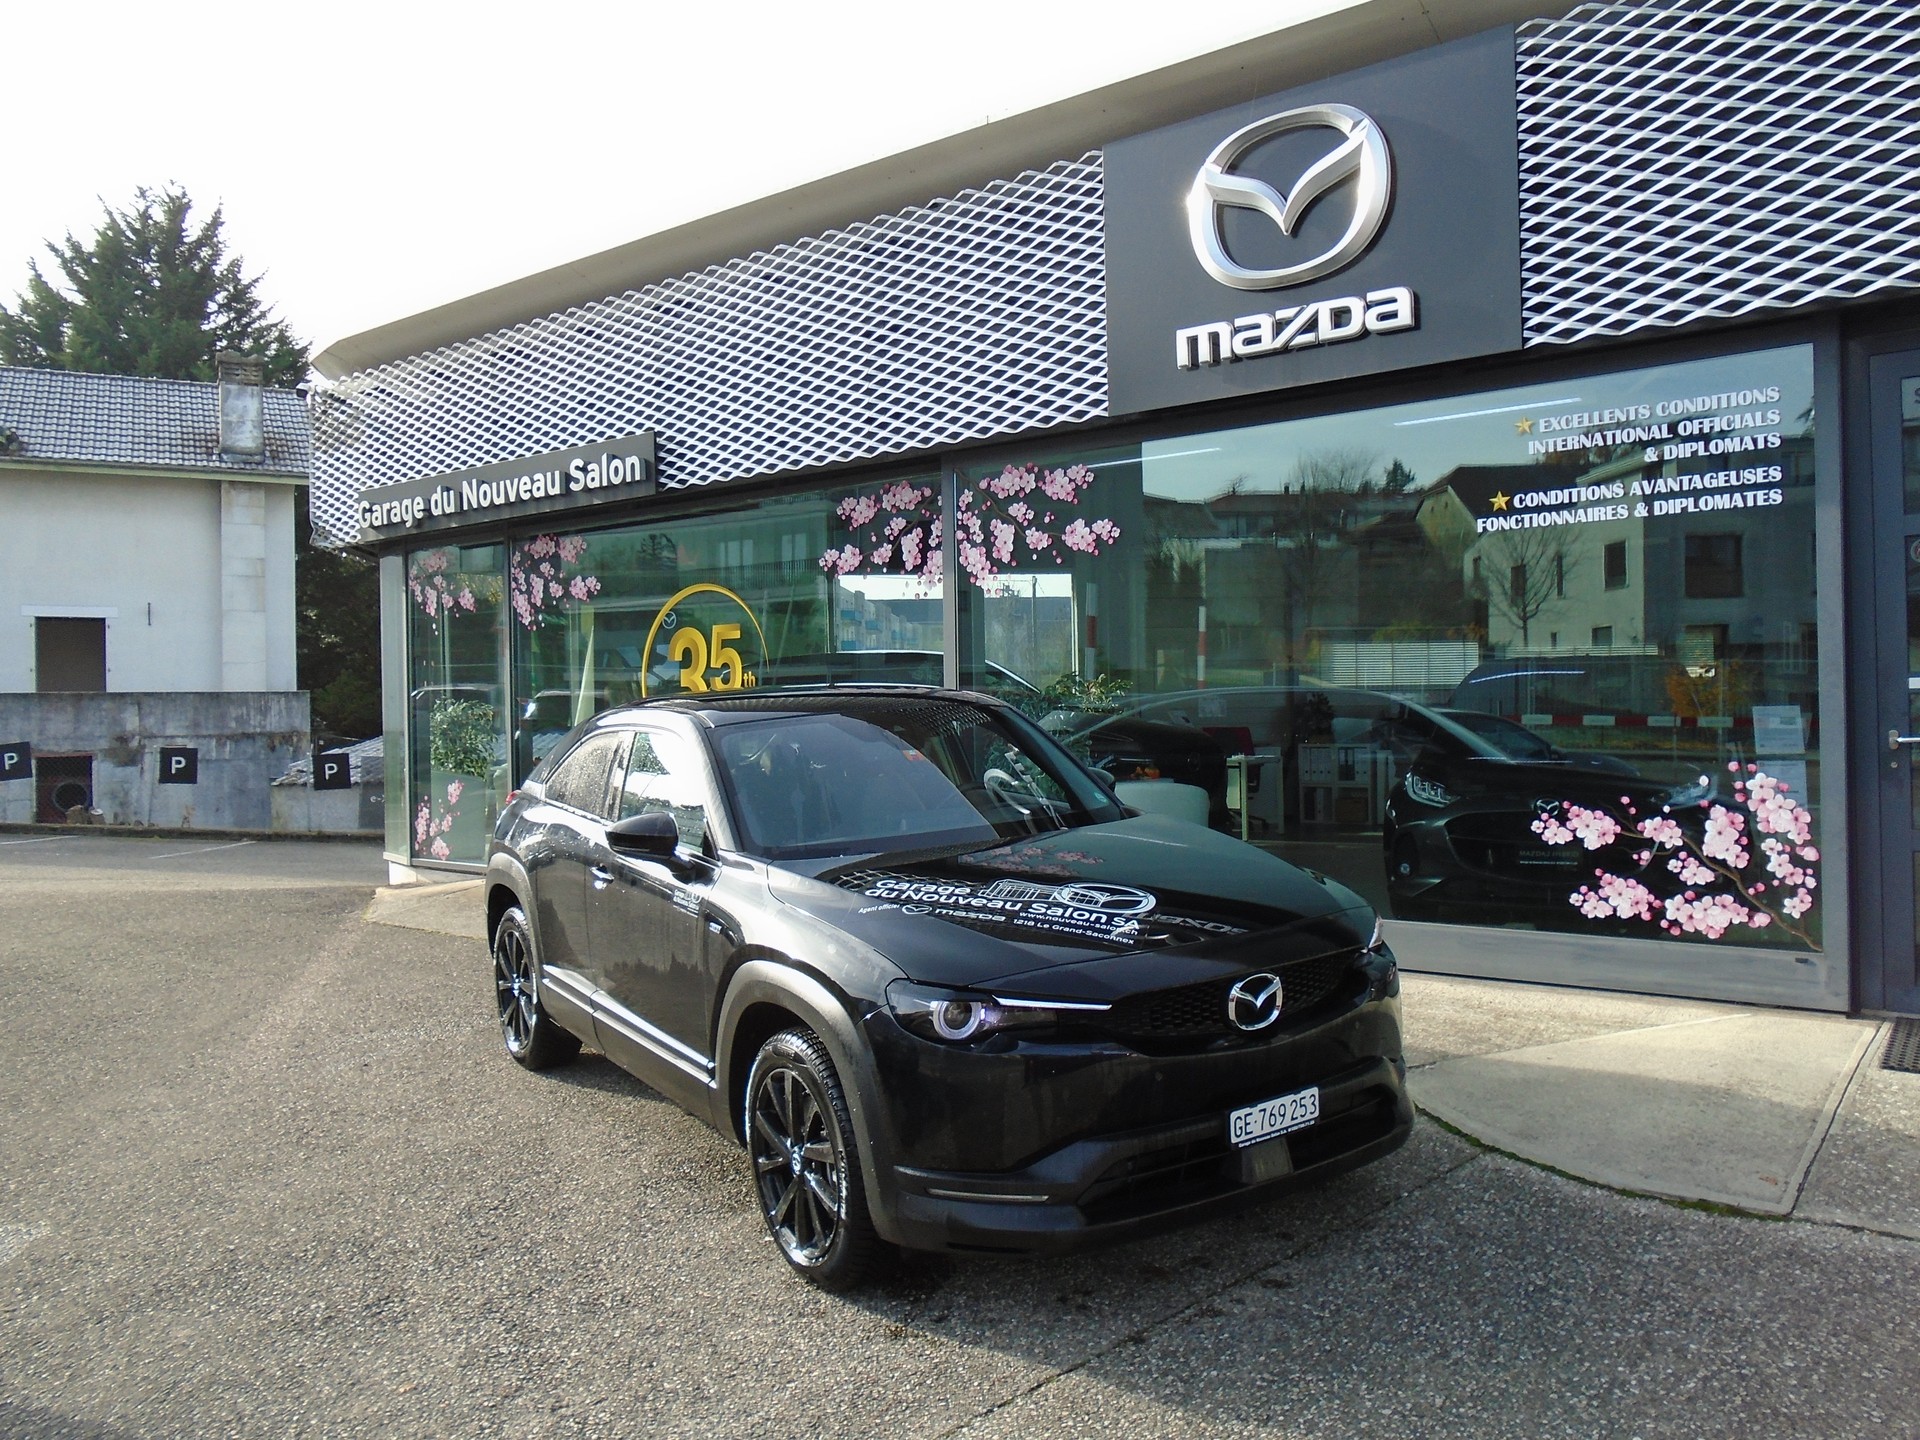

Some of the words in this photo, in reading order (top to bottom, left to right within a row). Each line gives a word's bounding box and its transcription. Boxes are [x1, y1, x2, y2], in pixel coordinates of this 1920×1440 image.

[1539, 404, 1651, 433] EXCELLENTS
[1656, 386, 1780, 417] CONDITIONS
[1528, 423, 1673, 455] INTERNATIONAL
[1677, 409, 1781, 437] OFFICIALS
[1644, 447, 1659, 463] &
[1663, 432, 1781, 461] DIPLOMATS
[358, 500, 424, 528] Garage
[430, 485, 455, 517] du
[462, 470, 561, 511] Nouveau
[569, 452, 641, 492] Salon
[1513, 483, 1625, 509] CONDITIONS
[1629, 465, 1783, 497] AVANTAGEUSES
[1477, 503, 1629, 533] FONCTIONNAIRES
[1633, 502, 1649, 518] &
[1653, 488, 1783, 516] DIPLOMATES
[3, 753, 18, 770] P
[171, 757, 186, 774] P
[325, 763, 338, 780] P
[876, 880, 971, 895] Garage
[865, 888, 899, 898] du
[901, 890, 1023, 912] Nouveau
[1027, 903, 1108, 923] Salon
[1111, 917, 1140, 930] SA
[1052, 924, 1135, 944] Grand-Saconnex
